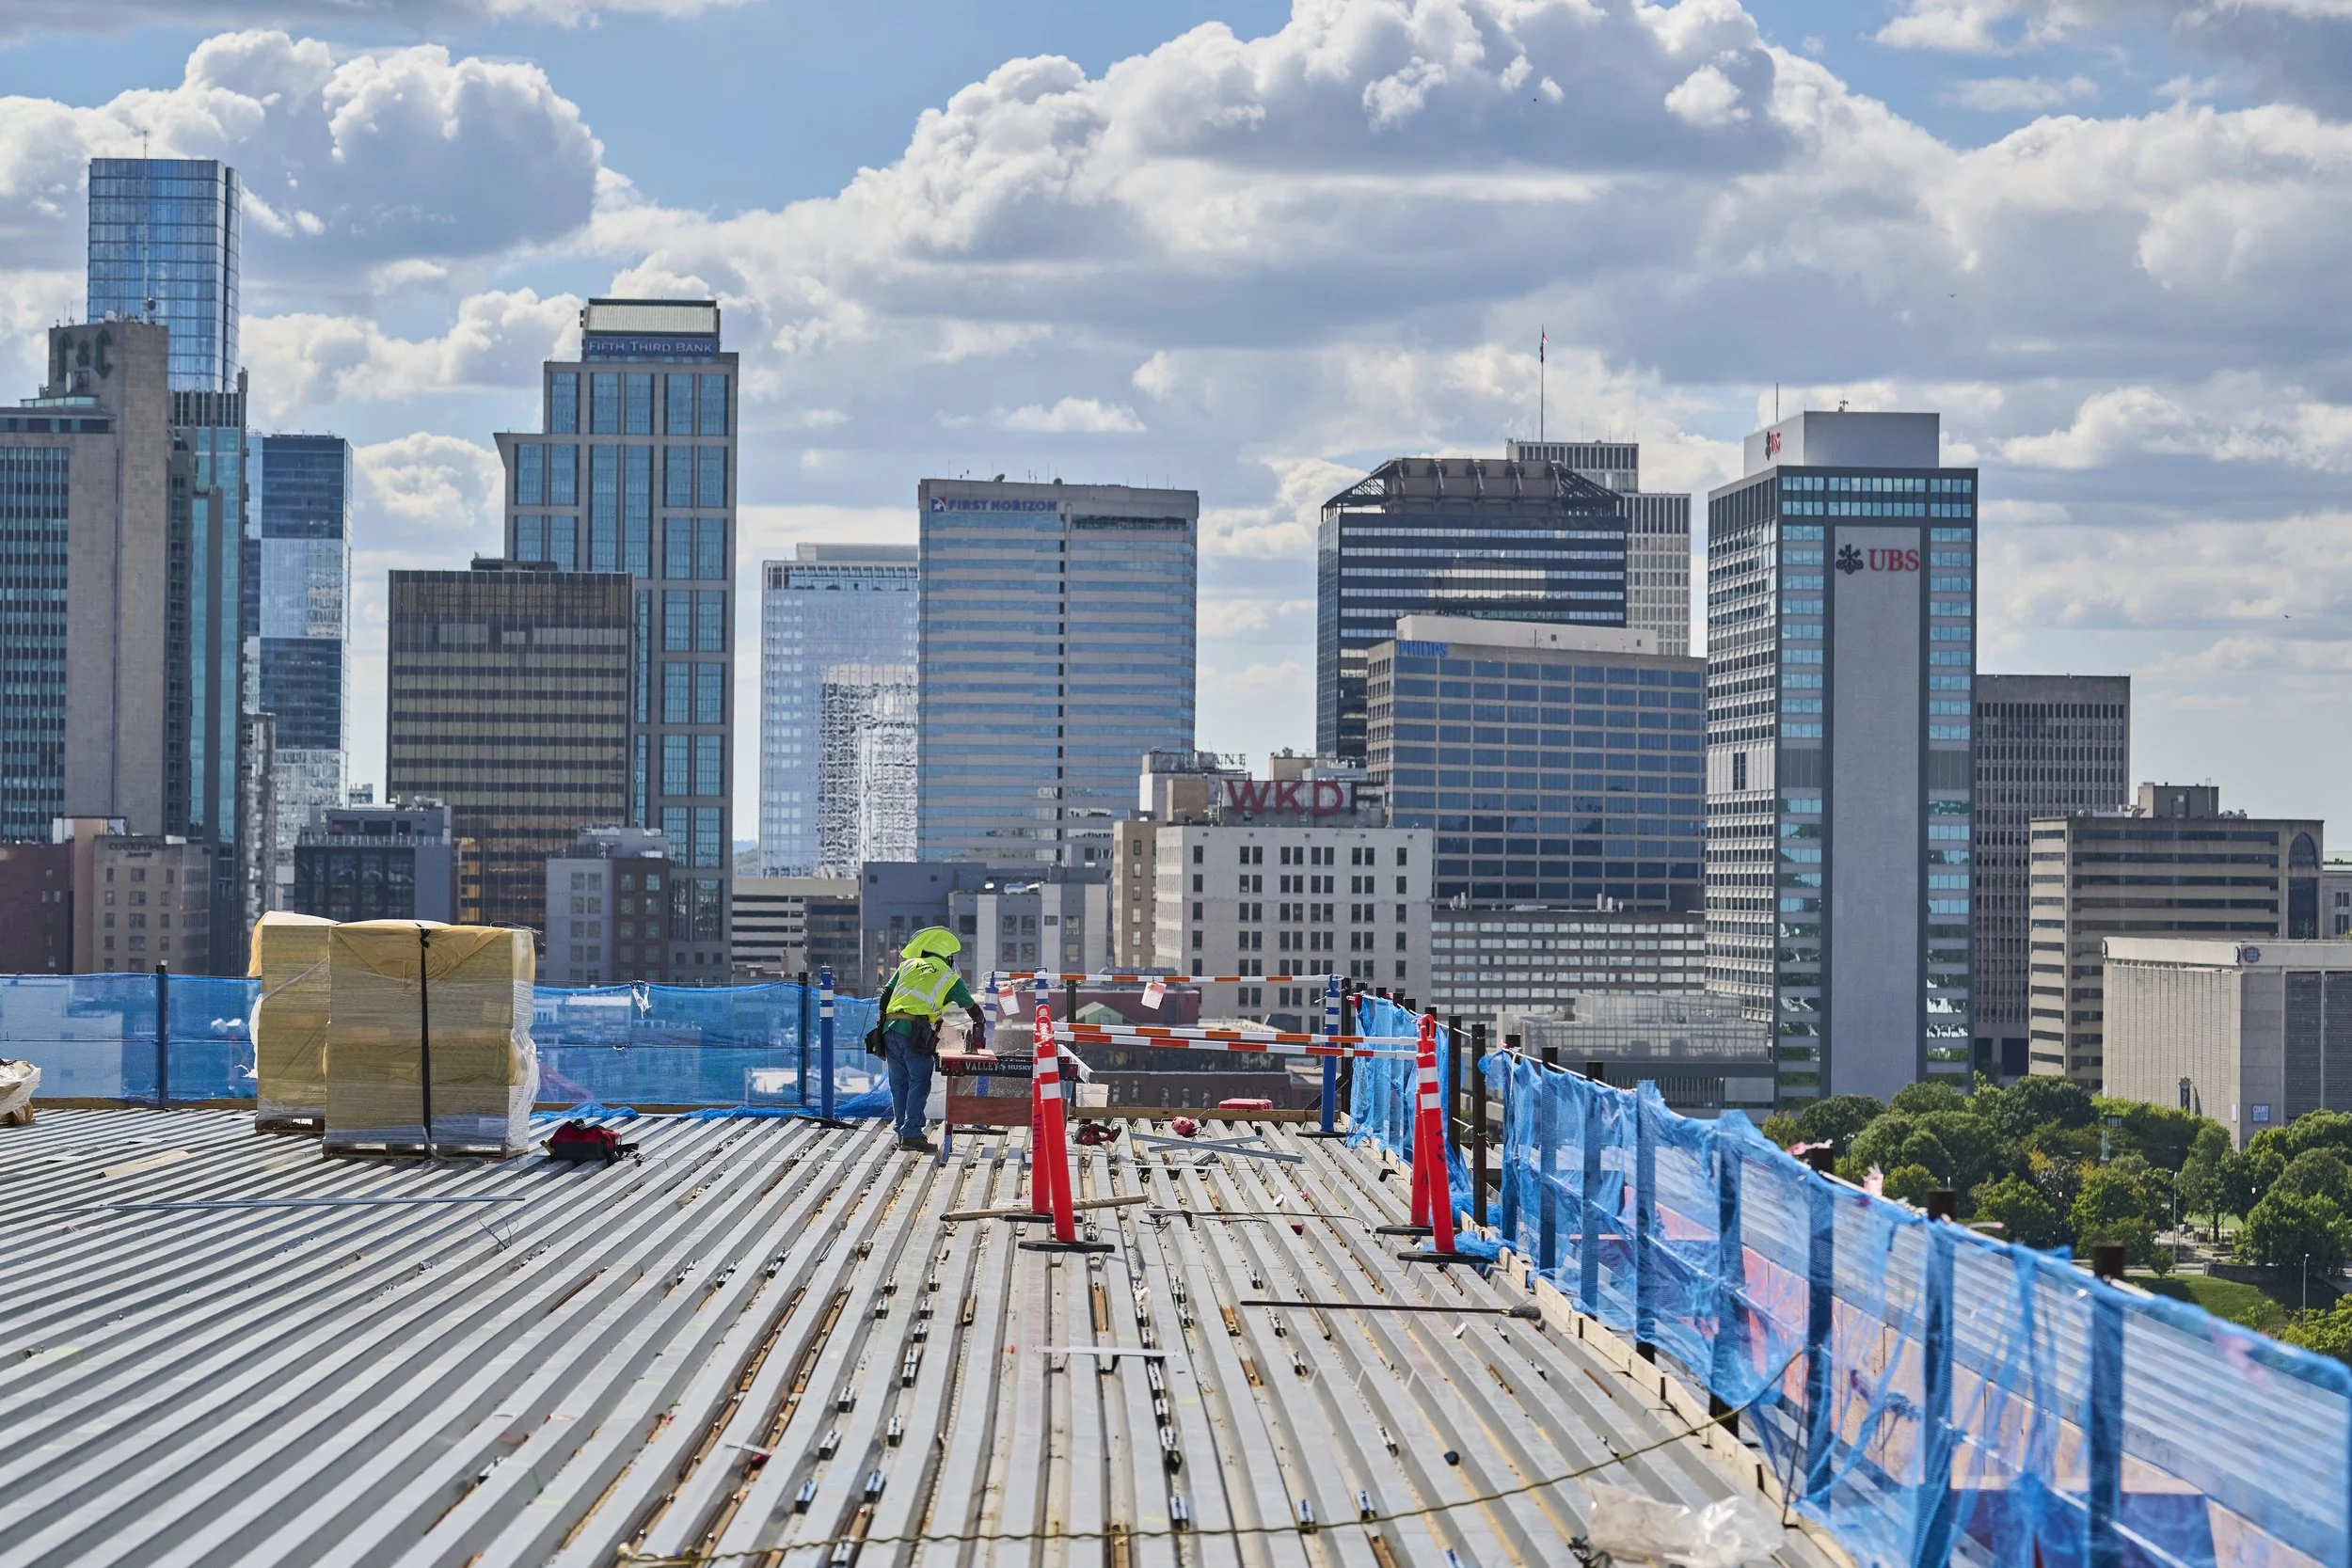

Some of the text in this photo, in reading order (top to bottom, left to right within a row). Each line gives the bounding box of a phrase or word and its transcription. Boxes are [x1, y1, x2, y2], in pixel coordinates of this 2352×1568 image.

[589, 341, 712, 353] FIFTH THIRD BANK
[948, 499, 1057, 512] FIRST HORIZON
[1868, 548, 1920, 572] UBS
[1399, 641, 1448, 658] PHILIPS
[965, 1062, 999, 1071] VALLEY
